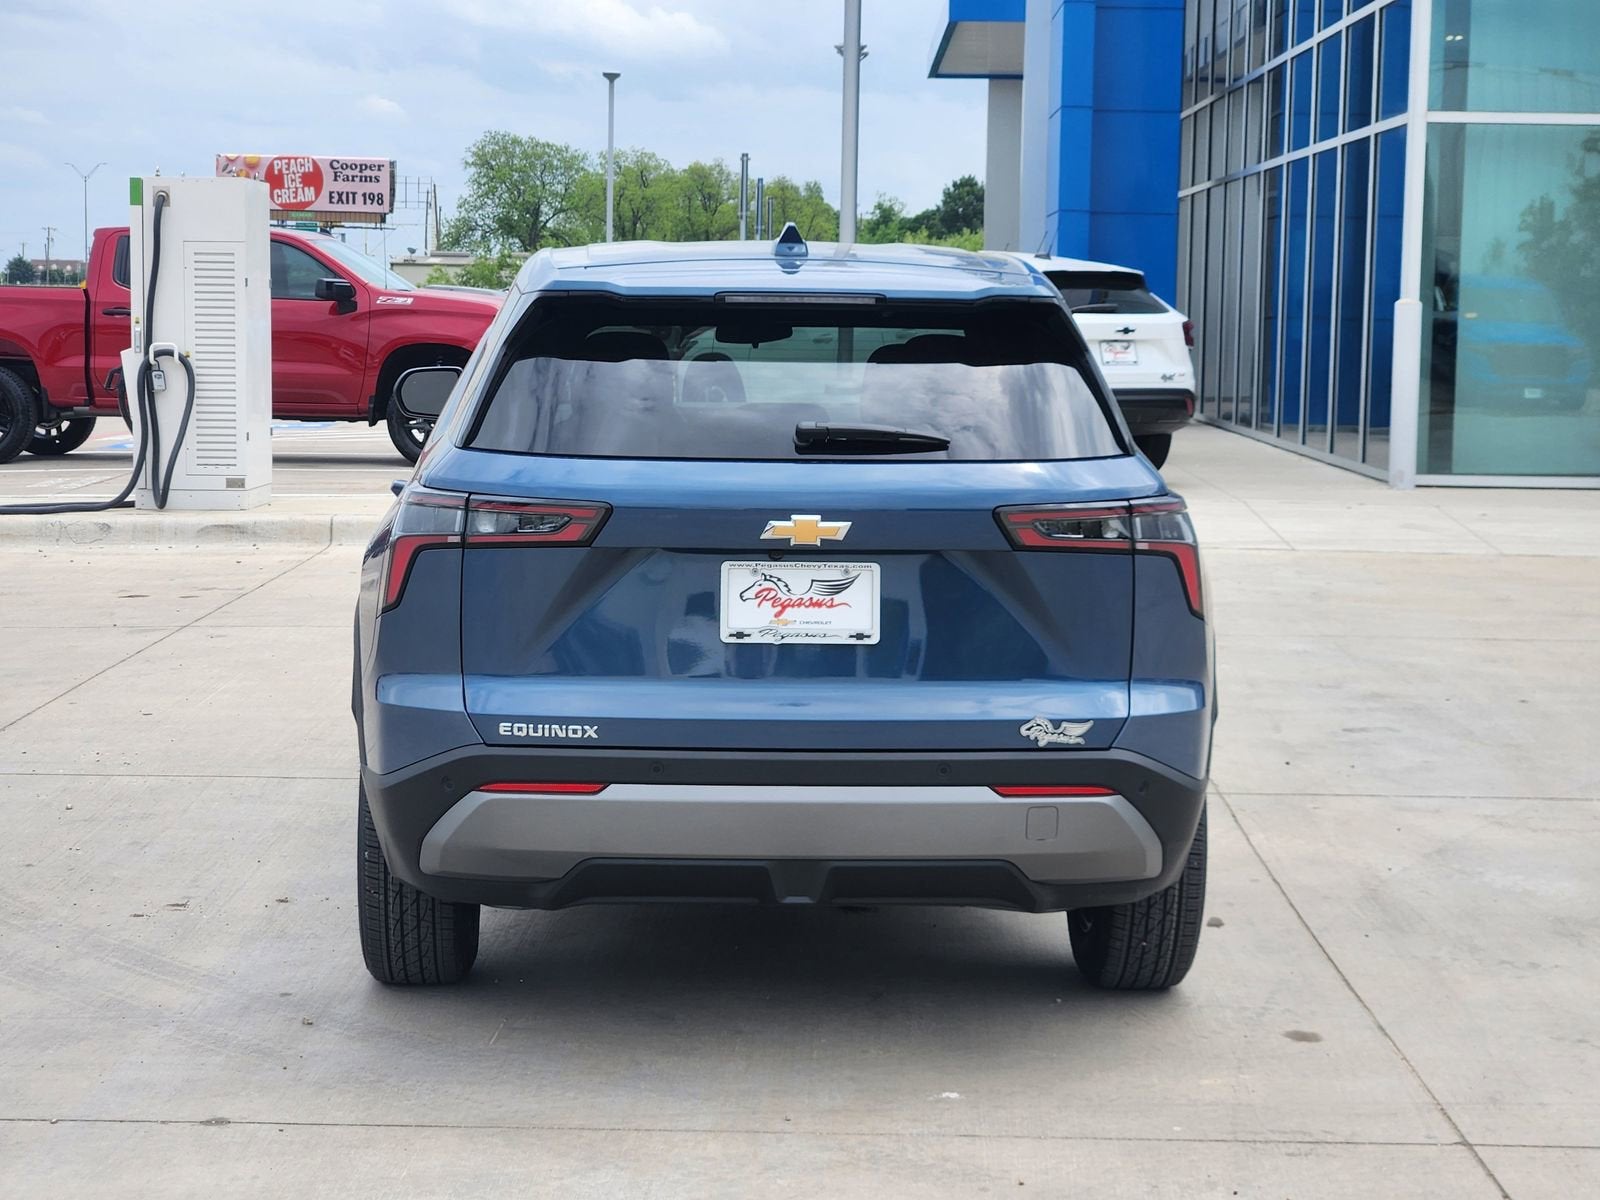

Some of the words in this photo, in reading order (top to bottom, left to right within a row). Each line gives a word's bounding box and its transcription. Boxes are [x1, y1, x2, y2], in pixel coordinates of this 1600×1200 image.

[273, 159, 314, 175] PEACH
[330, 160, 385, 173] Cooper
[284, 174, 304, 189] ICE
[333, 172, 381, 184] Farms
[273, 188, 315, 205] CREAM
[328, 191, 358, 205] EXIT
[362, 193, 384, 206] 198
[728, 562, 873, 570] www.PegasusChevyTexas.com
[755, 587, 852, 618] Pegasus
[757, 628, 842, 642] Pegasus
[498, 722, 599, 738] EQUINOX
